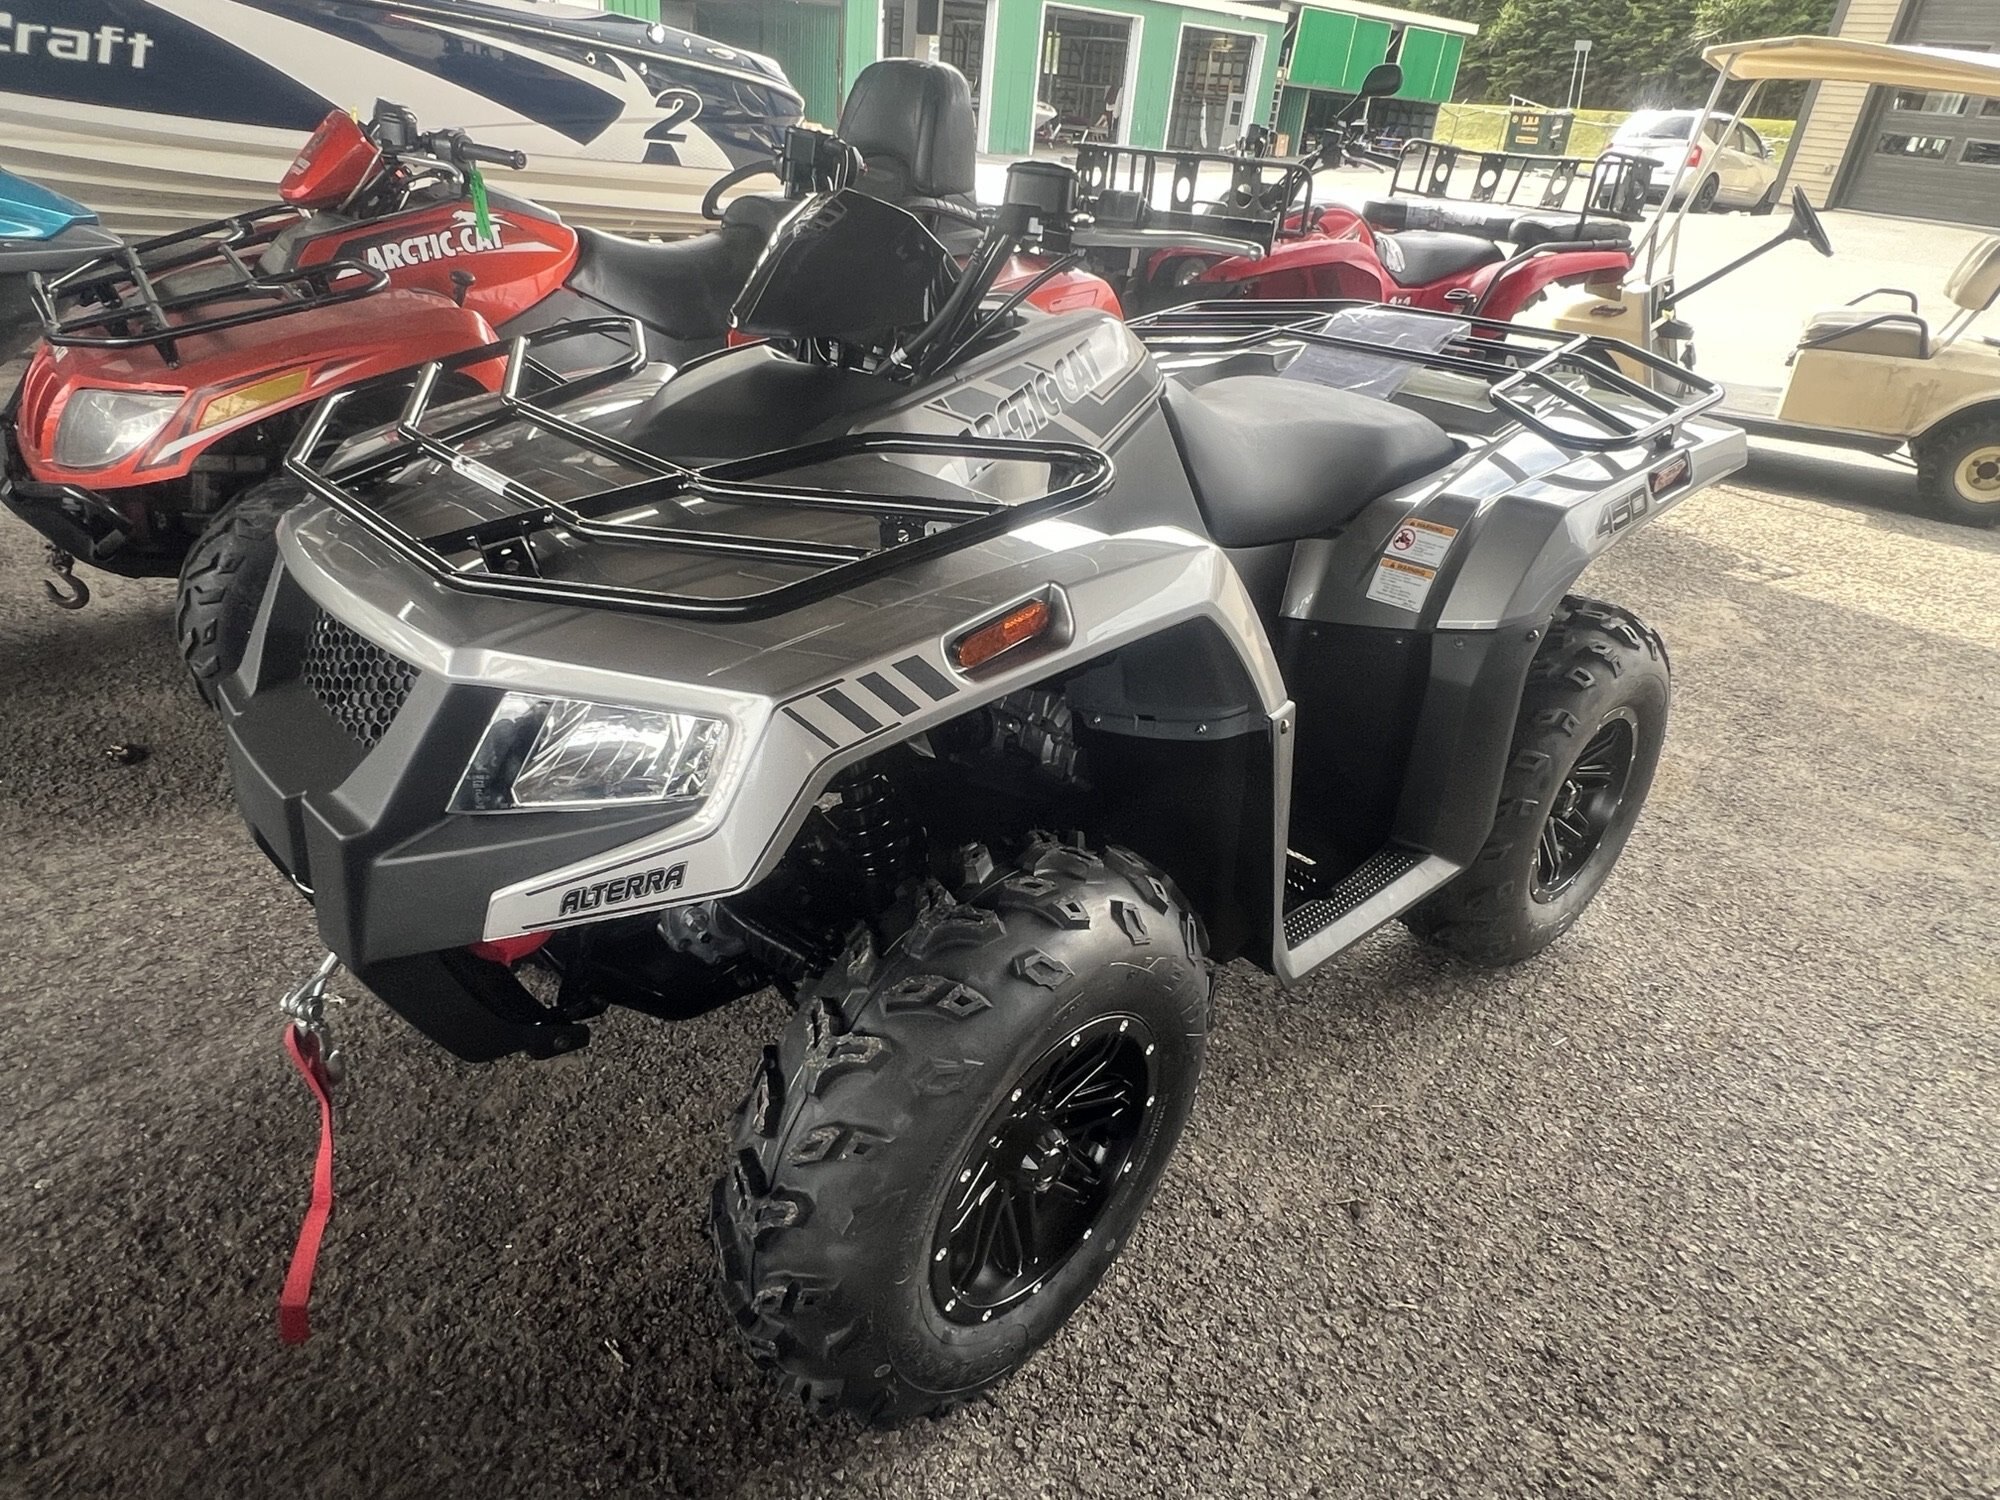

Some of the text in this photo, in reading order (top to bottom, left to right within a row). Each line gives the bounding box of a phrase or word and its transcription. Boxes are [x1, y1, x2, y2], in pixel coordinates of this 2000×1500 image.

[367, 231, 457, 272] ARCTIC
[1054, 338, 1101, 404] CAT
[1596, 484, 1649, 539] 450
[559, 861, 688, 917] ALTERRA
